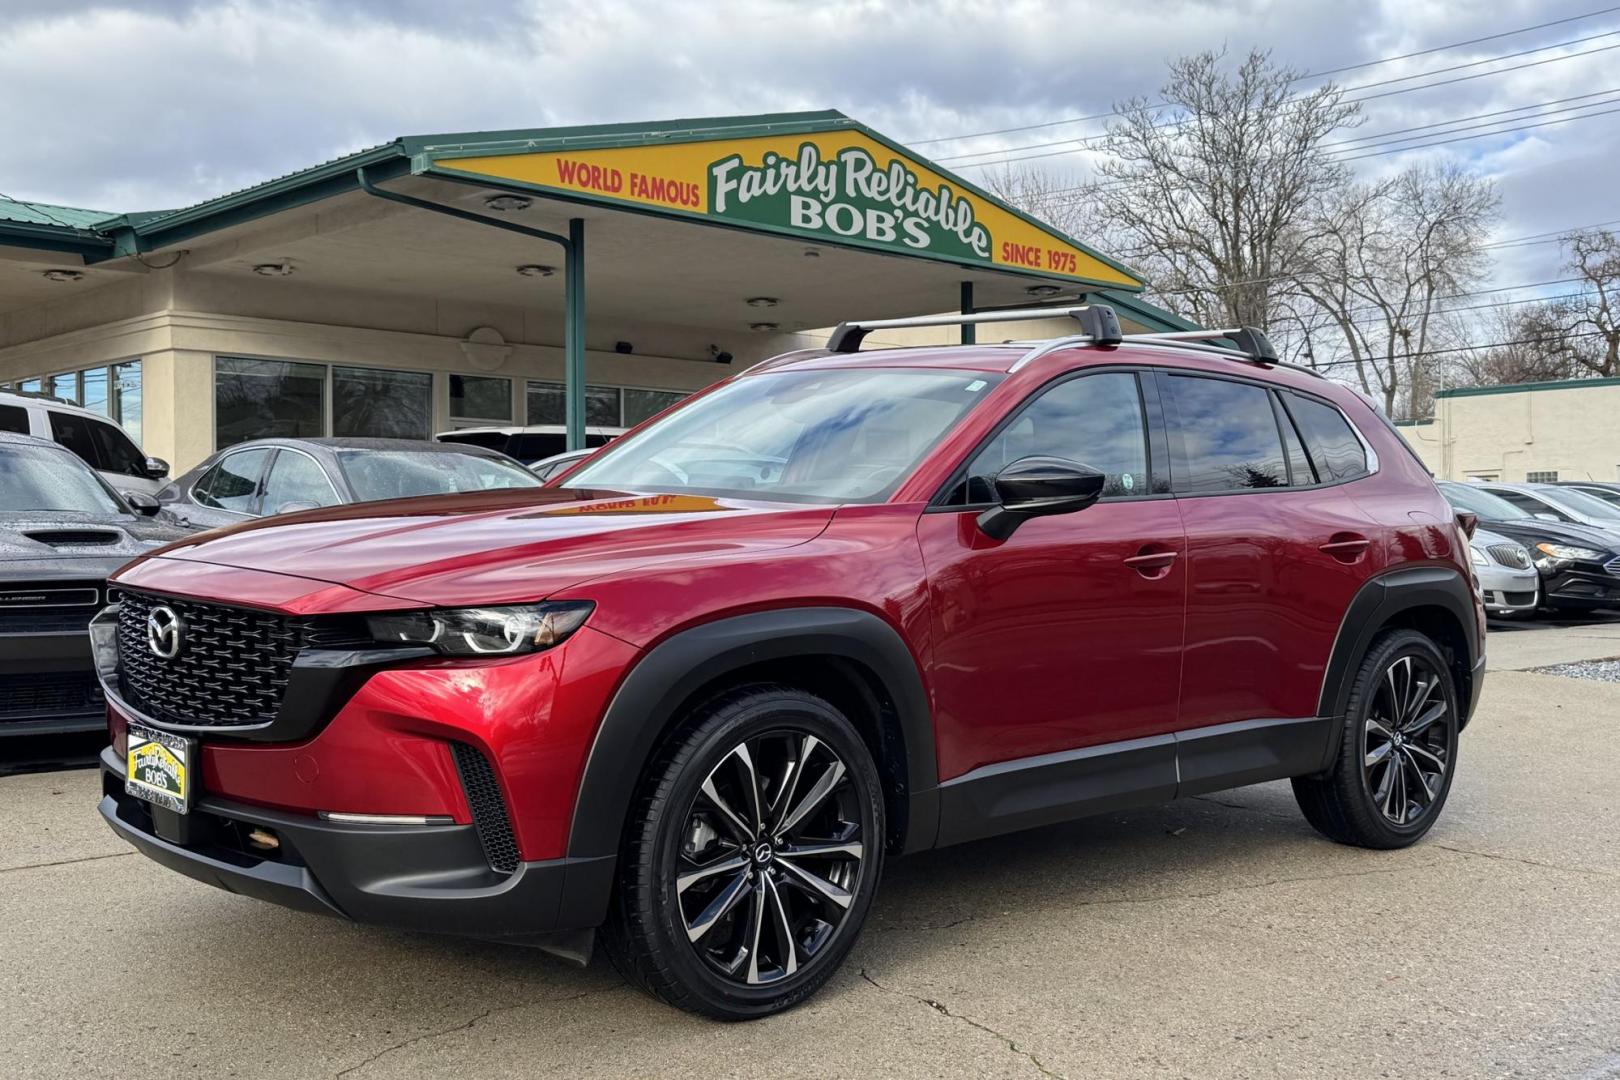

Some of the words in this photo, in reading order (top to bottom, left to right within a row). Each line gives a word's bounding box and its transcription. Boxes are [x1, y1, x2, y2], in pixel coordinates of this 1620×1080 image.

[556, 158, 623, 193] WORLD
[630, 172, 700, 207] FAMOUS
[712, 146, 838, 213] Fairly
[840, 150, 990, 257] Reliable
[790, 195, 931, 248] BOB'S
[1002, 241, 1041, 267] SINCE
[1047, 249, 1077, 273] 1975
